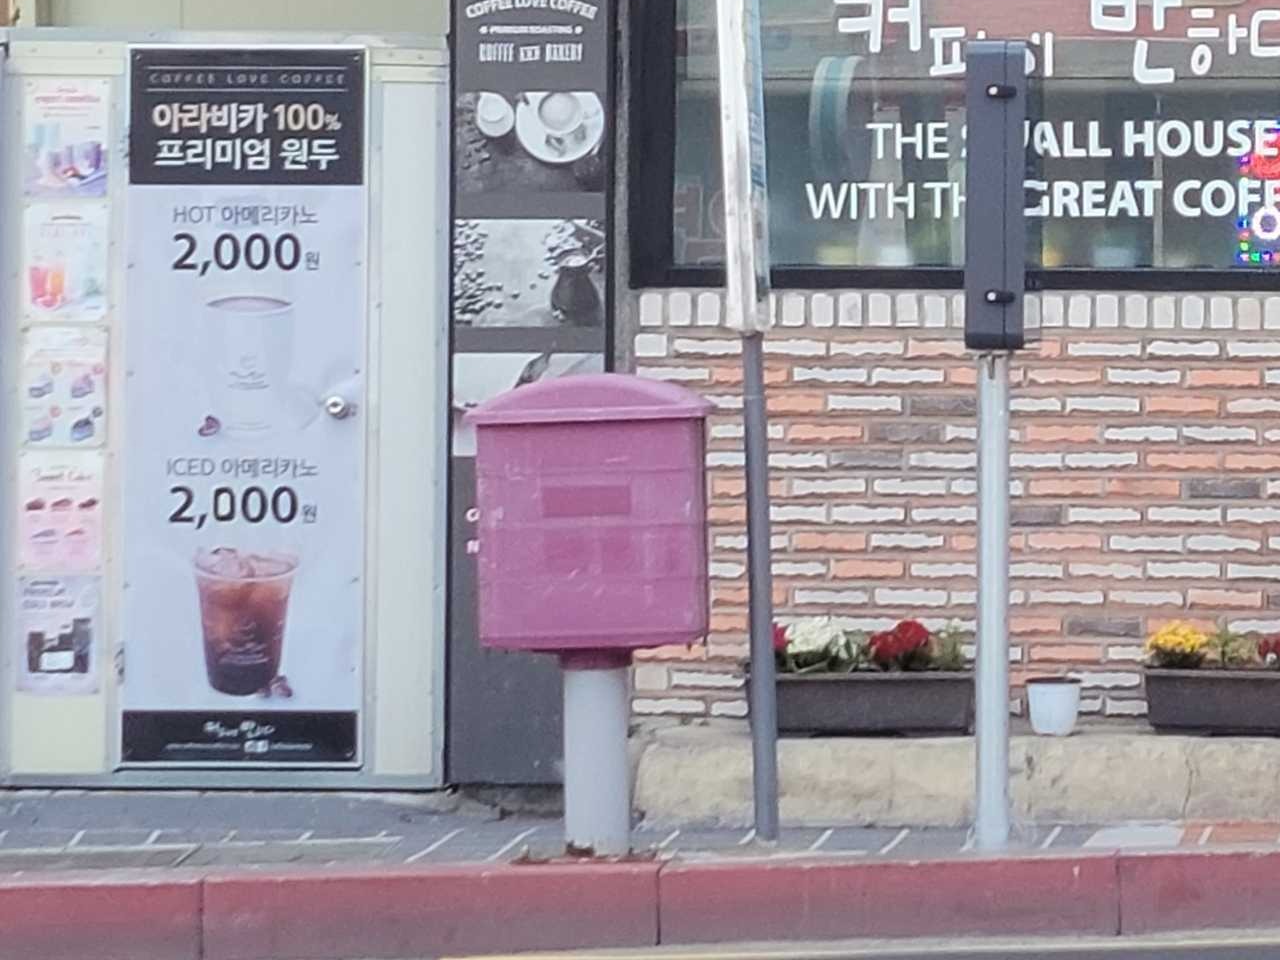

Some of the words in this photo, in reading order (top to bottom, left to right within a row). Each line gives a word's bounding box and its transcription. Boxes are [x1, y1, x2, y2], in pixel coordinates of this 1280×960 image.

[226, 73, 270, 85] LOVE
[152, 102, 269, 134] 아라비카
[272, 103, 342, 132] 100%
[153, 138, 270, 171] 프리미엄
[279, 139, 340, 170] 원두
[866, 122, 949, 159] THE
[962, 119, 1112, 158] ALL
[1123, 119, 1280, 158] HOUSE
[172, 205, 217, 224] HOT
[220, 204, 319, 226] 아메리카노
[805, 182, 916, 220] WITH
[923, 182, 967, 219] TH
[166, 457, 216, 477] ICED
[220, 456, 319, 478] 아메리카노
